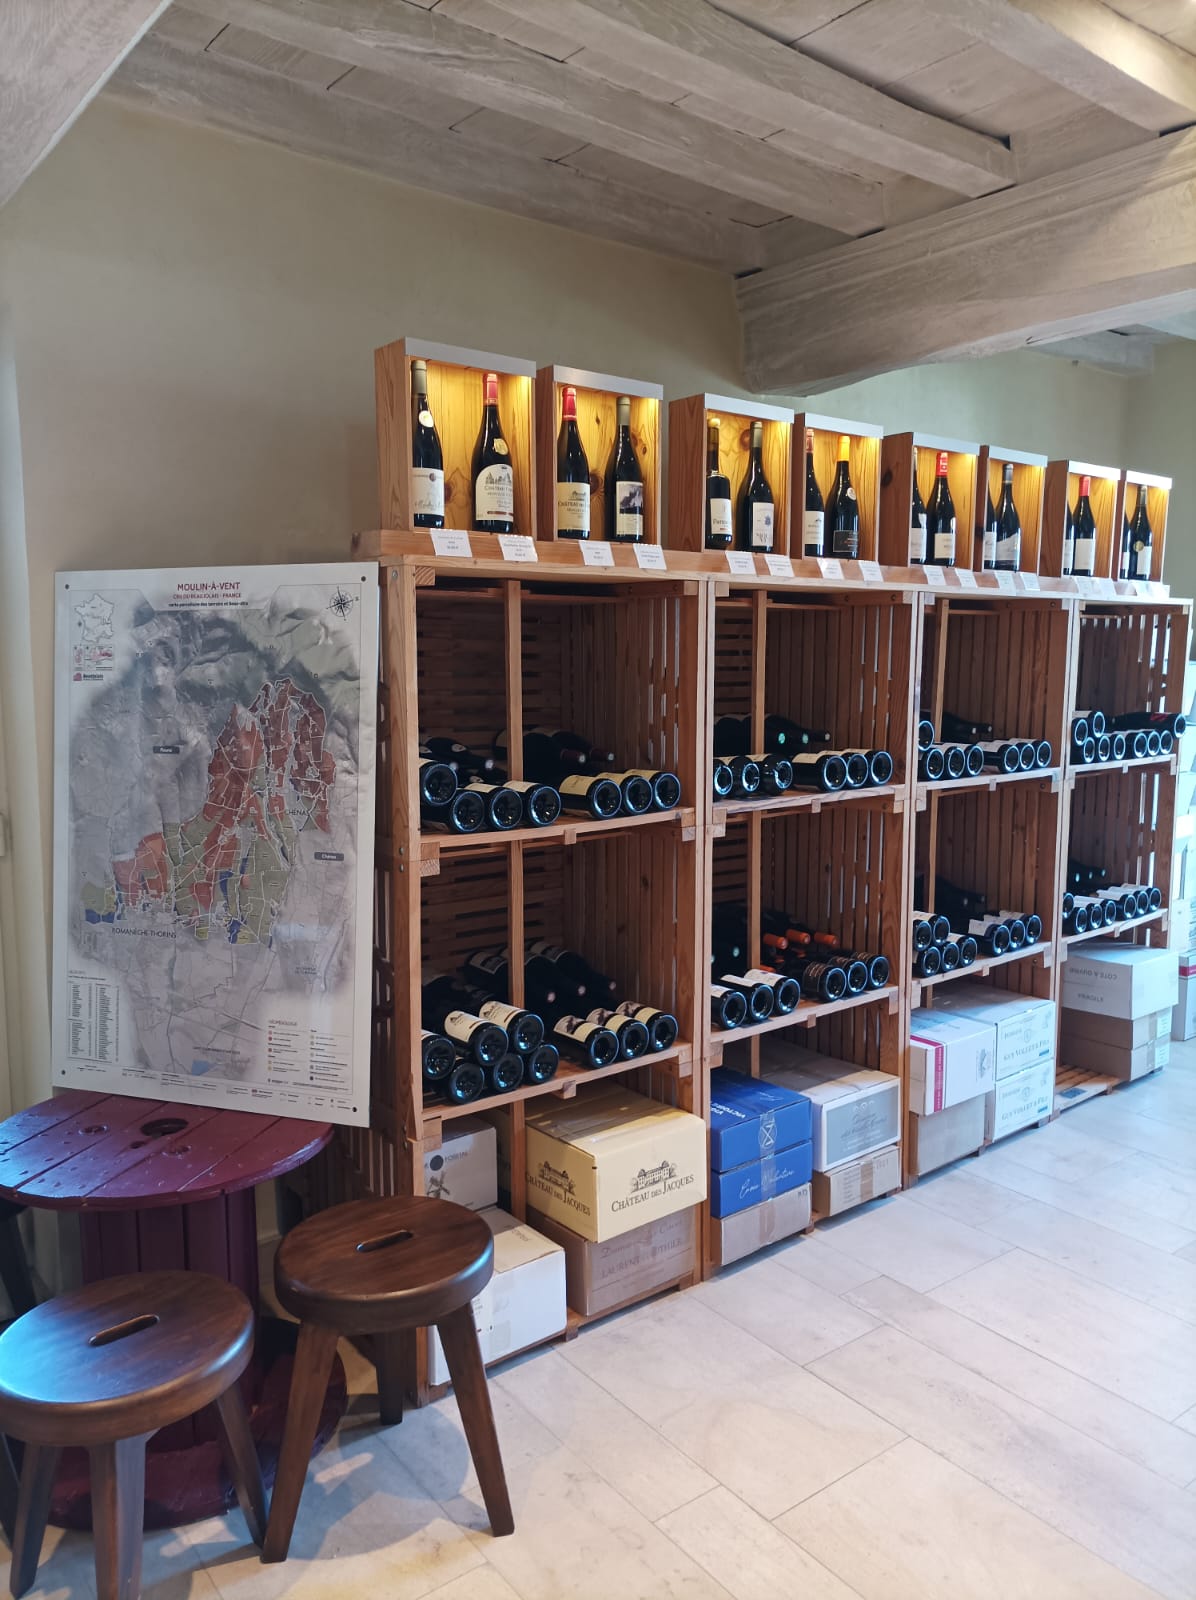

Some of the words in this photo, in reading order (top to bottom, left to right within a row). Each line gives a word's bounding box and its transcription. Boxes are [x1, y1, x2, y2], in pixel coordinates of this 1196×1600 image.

[177, 581, 241, 592] MOULIN-À-VENT
[563, 1190, 591, 1217] JACQUES
[611, 1190, 650, 1213] CHÂTEAU
[651, 1188, 663, 1199] DES
[662, 1174, 695, 1195] JACQUES
